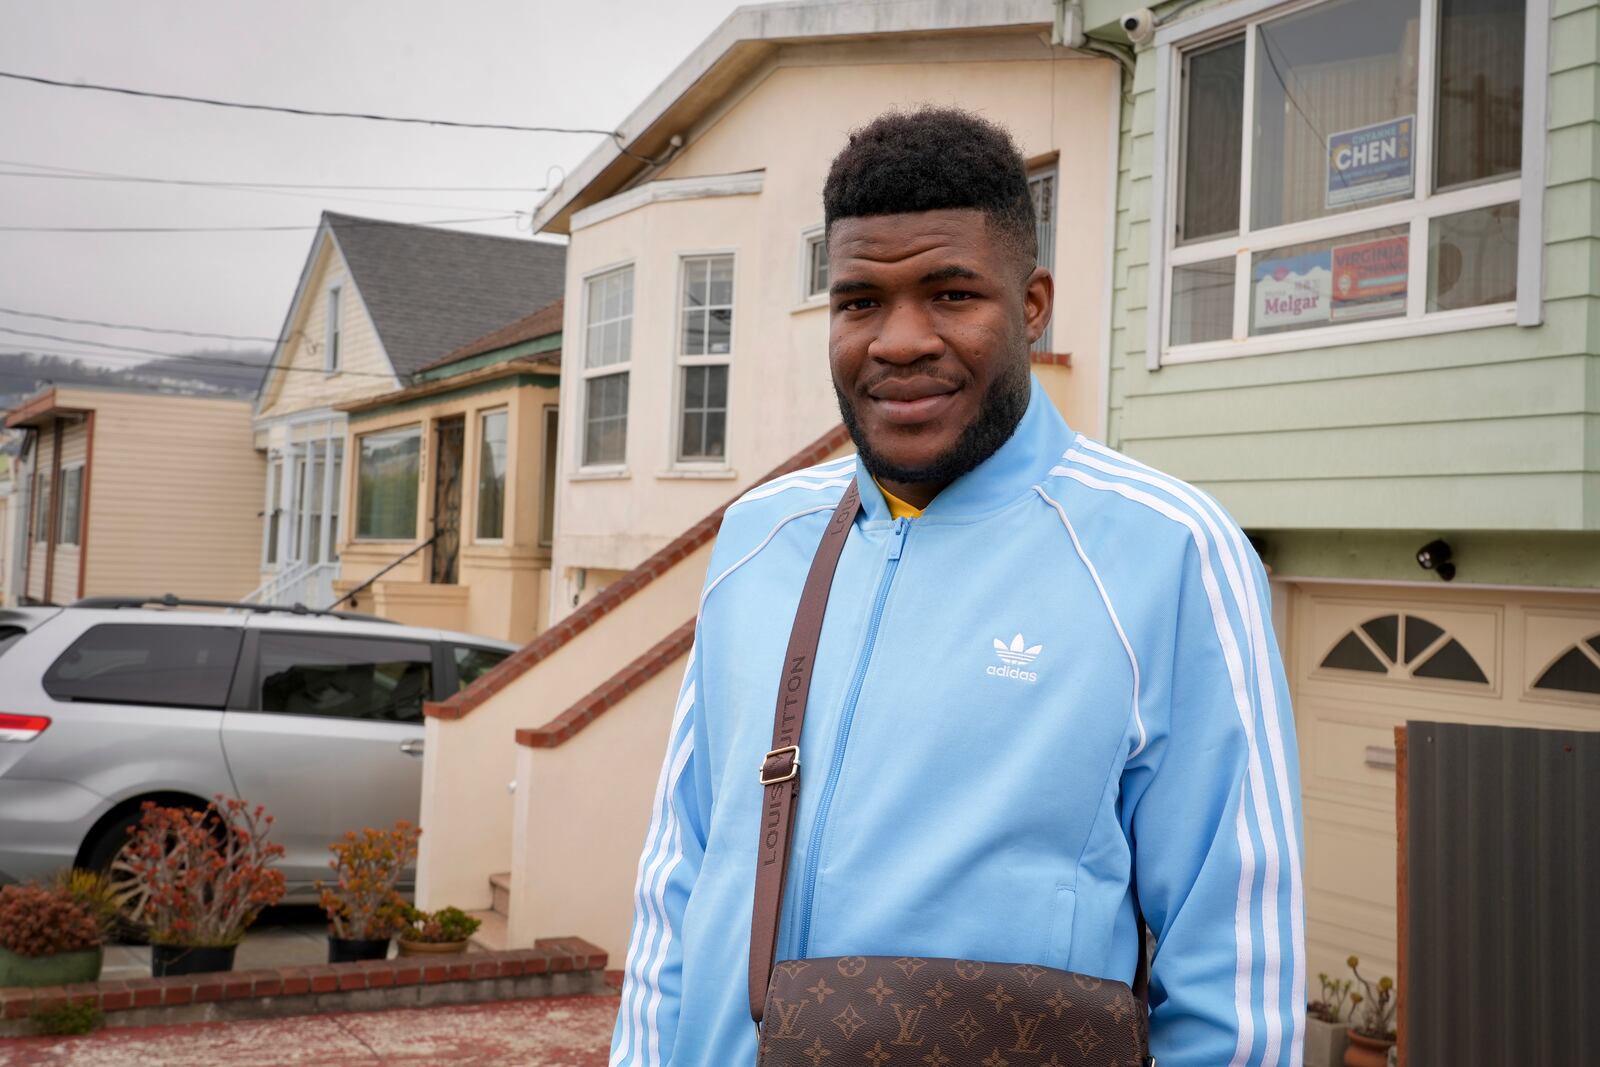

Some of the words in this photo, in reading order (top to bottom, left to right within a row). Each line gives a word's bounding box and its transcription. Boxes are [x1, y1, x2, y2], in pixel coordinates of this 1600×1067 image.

[1335, 137, 1397, 171] CHEN
[1335, 244, 1405, 267] VIRGINIA
[1264, 294, 1320, 316] Melgar
[986, 665, 1038, 682] adidas
[763, 783, 784, 866] LOUIS
